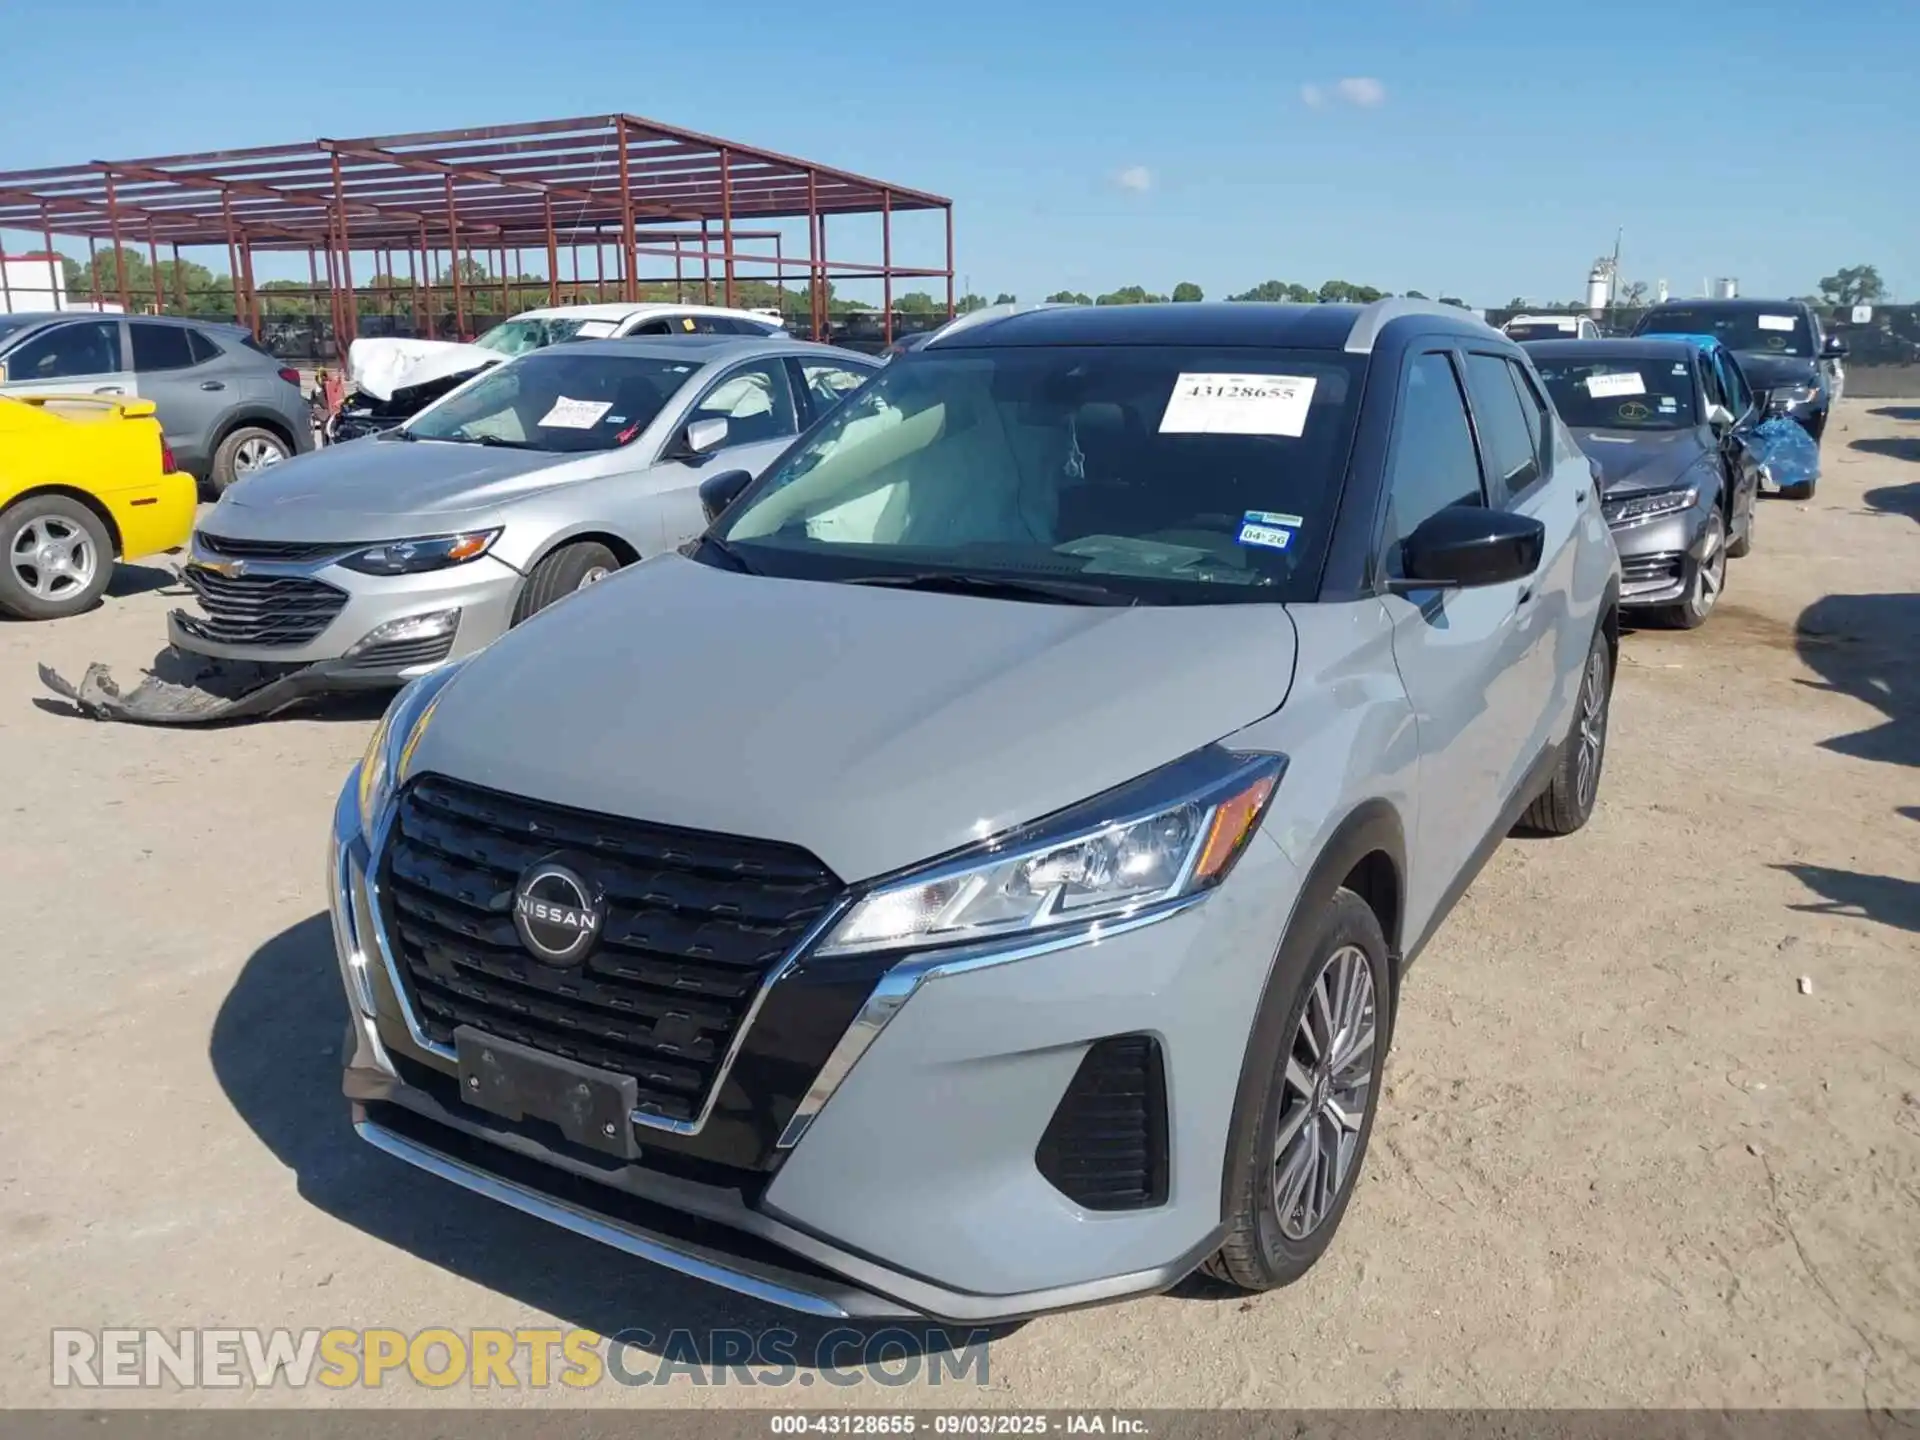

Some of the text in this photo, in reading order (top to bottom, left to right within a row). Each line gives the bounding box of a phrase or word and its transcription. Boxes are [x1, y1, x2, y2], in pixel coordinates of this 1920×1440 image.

[1185, 386, 1296, 399] 43128655
[1244, 530, 1285, 545] 04 26
[518, 897, 595, 929] NISSAN
